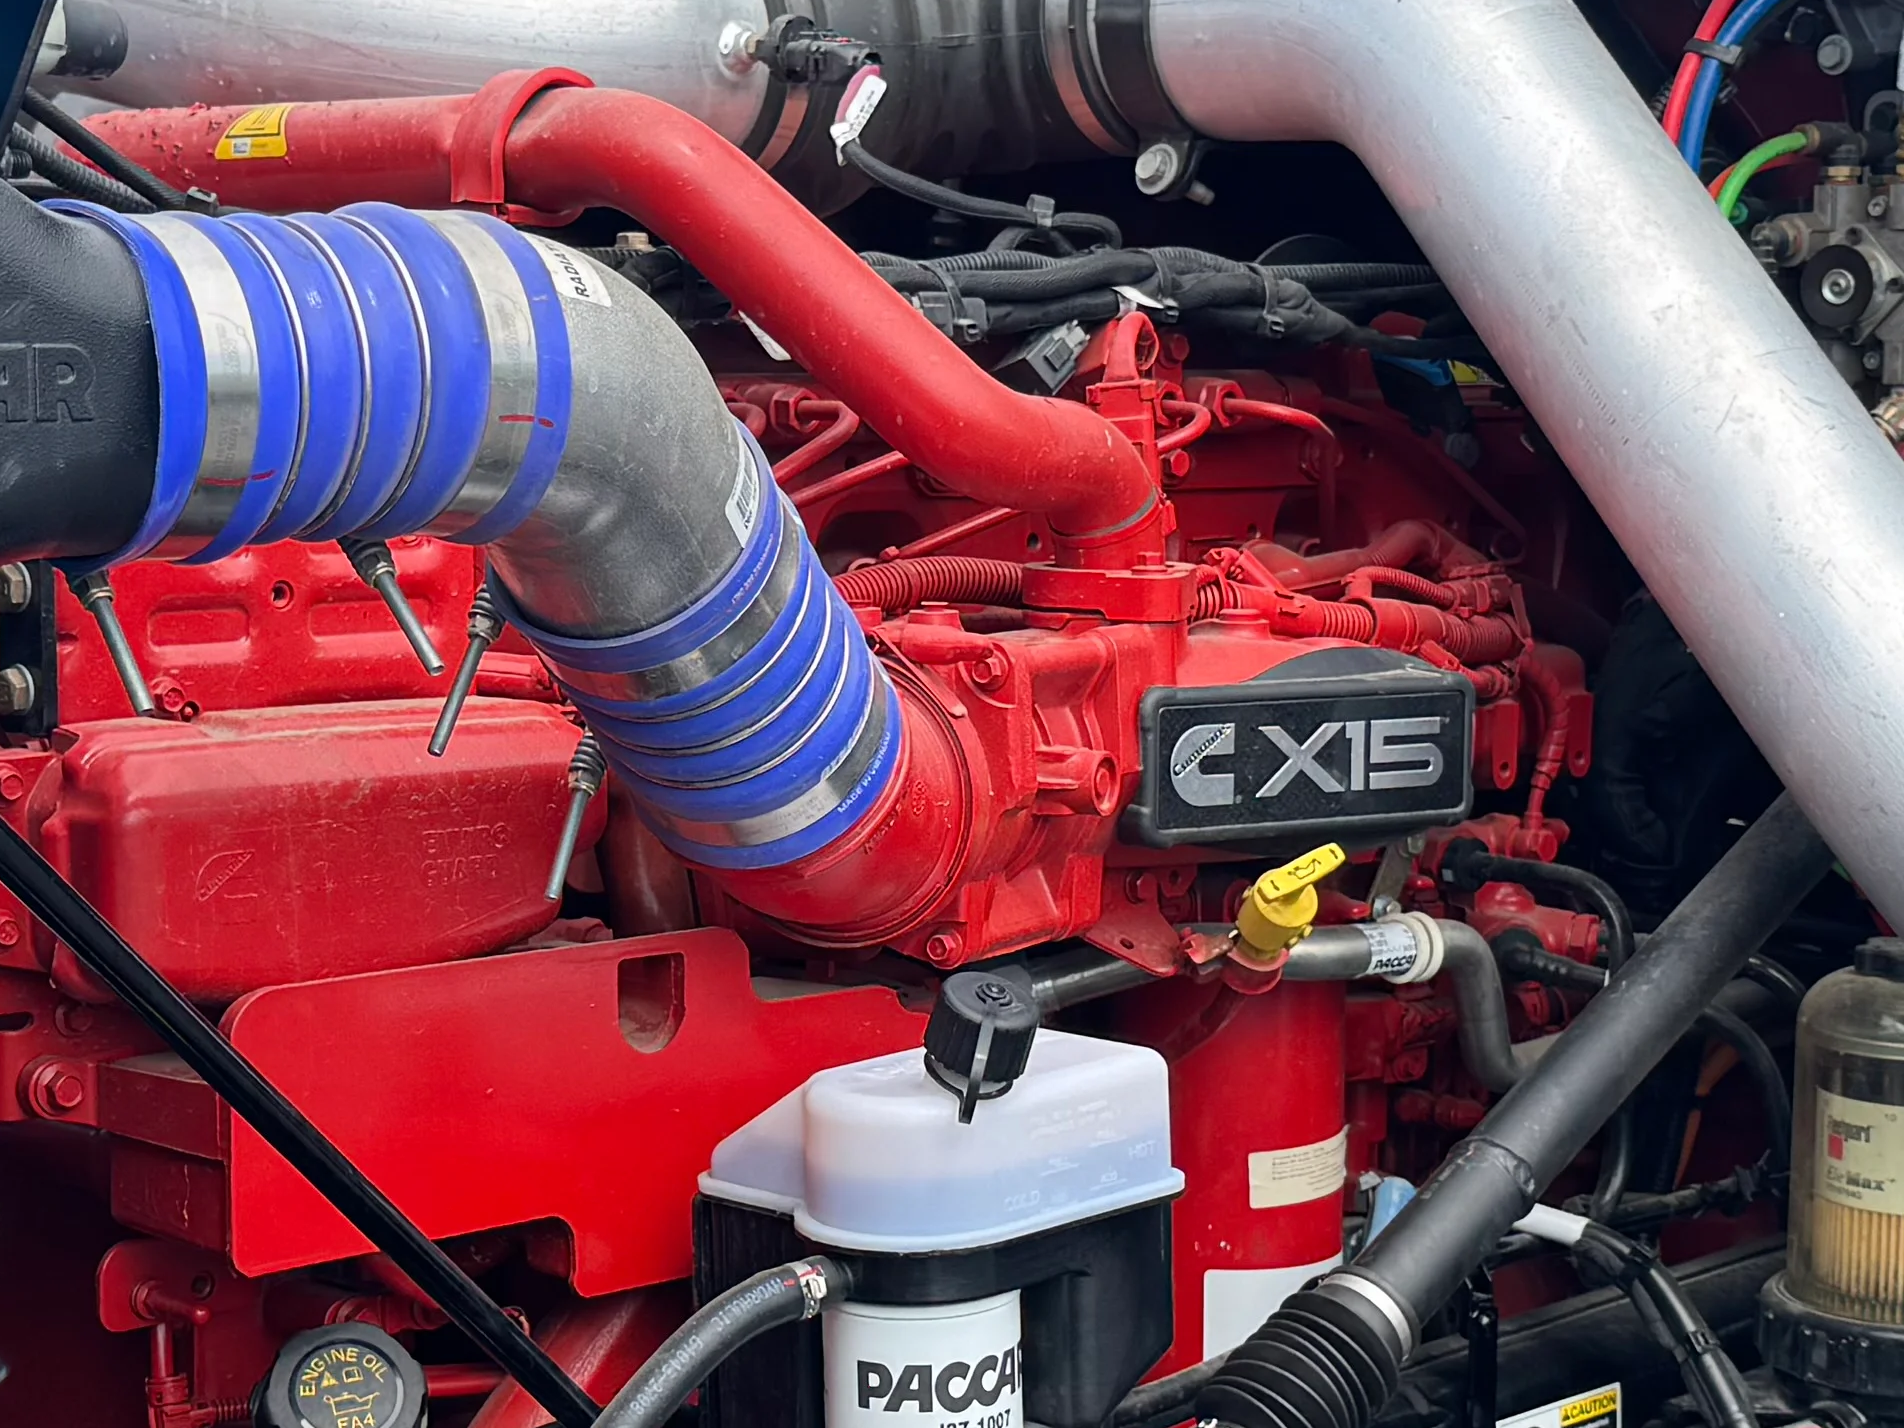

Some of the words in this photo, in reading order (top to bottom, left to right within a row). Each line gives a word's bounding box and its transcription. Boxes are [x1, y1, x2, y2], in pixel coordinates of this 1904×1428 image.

[1171, 721, 1233, 778] Cummins
[1255, 716, 1442, 798] X15
[837, 786, 863, 813] MADE
[710, 1276, 786, 1332] HYDRAULIC
[299, 1347, 360, 1398] ENGINE
[362, 1353, 389, 1384] OIL
[857, 1341, 1022, 1413] PACCA
[1570, 1392, 1618, 1420] CAUTION
